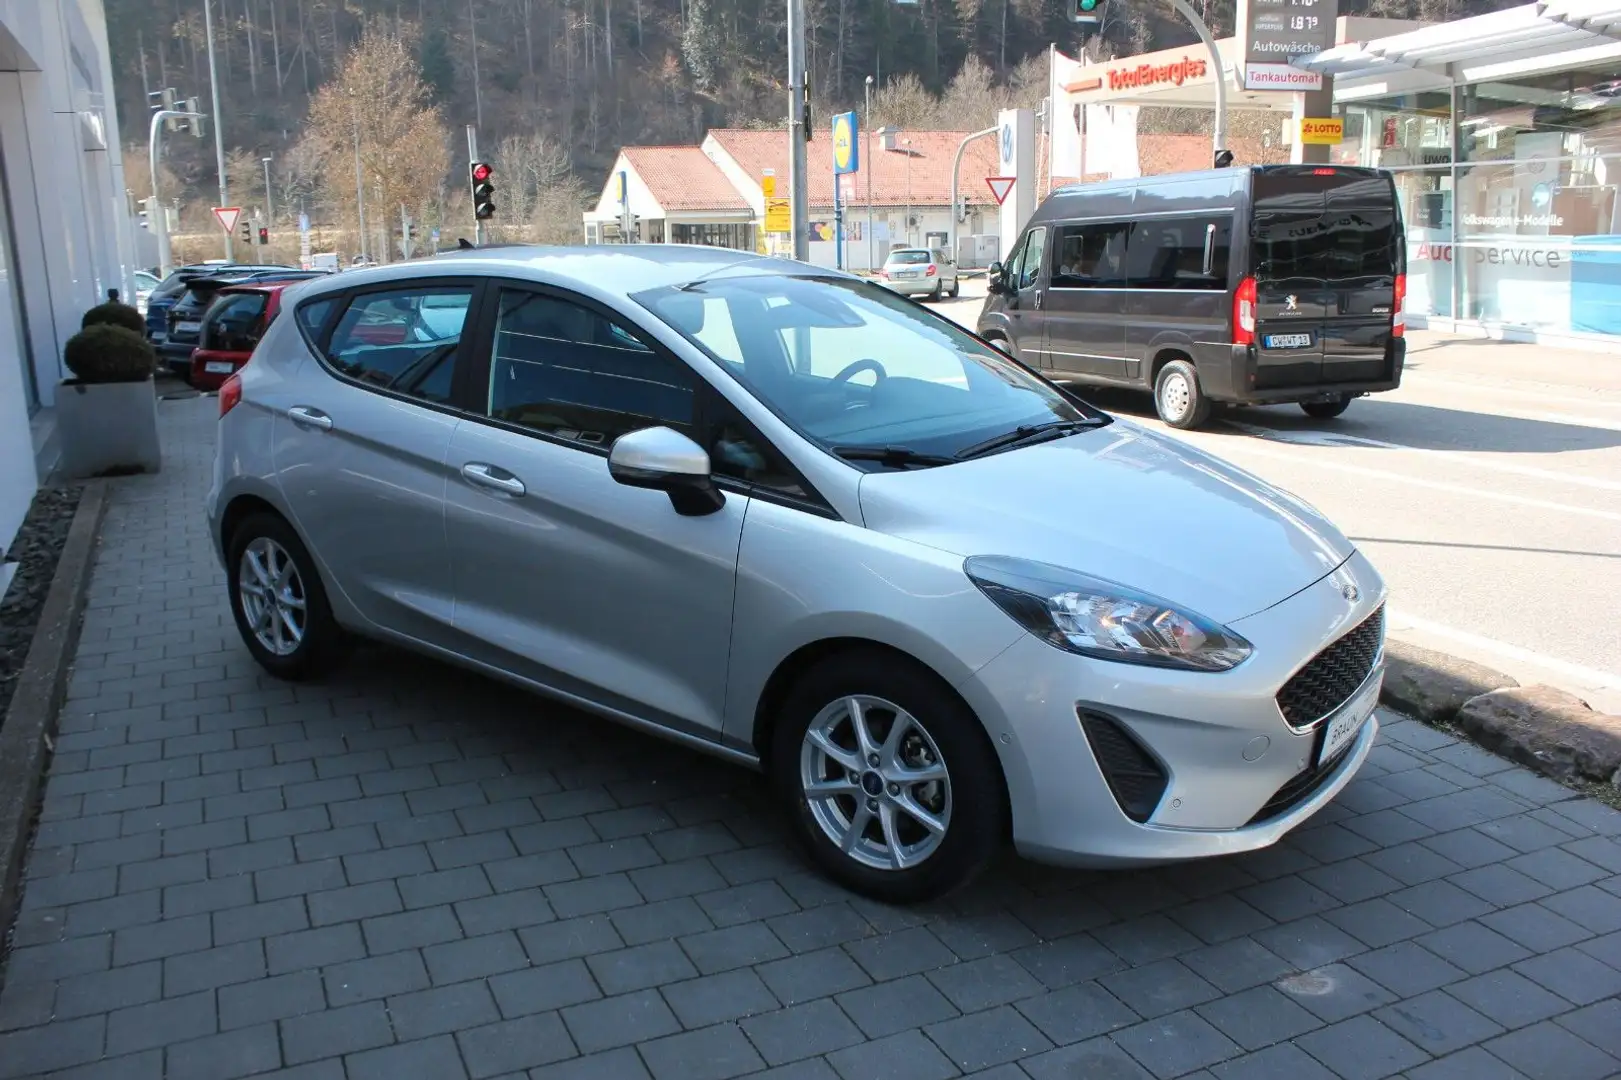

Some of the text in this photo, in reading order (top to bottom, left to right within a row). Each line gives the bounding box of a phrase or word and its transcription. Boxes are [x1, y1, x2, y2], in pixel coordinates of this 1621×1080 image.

[1252, 40, 1321, 53] Autowäsche
[1107, 56, 1206, 89] TotalEnergies
[1249, 70, 1320, 83] Tankautomat
[1314, 124, 1341, 134] LOTTO
